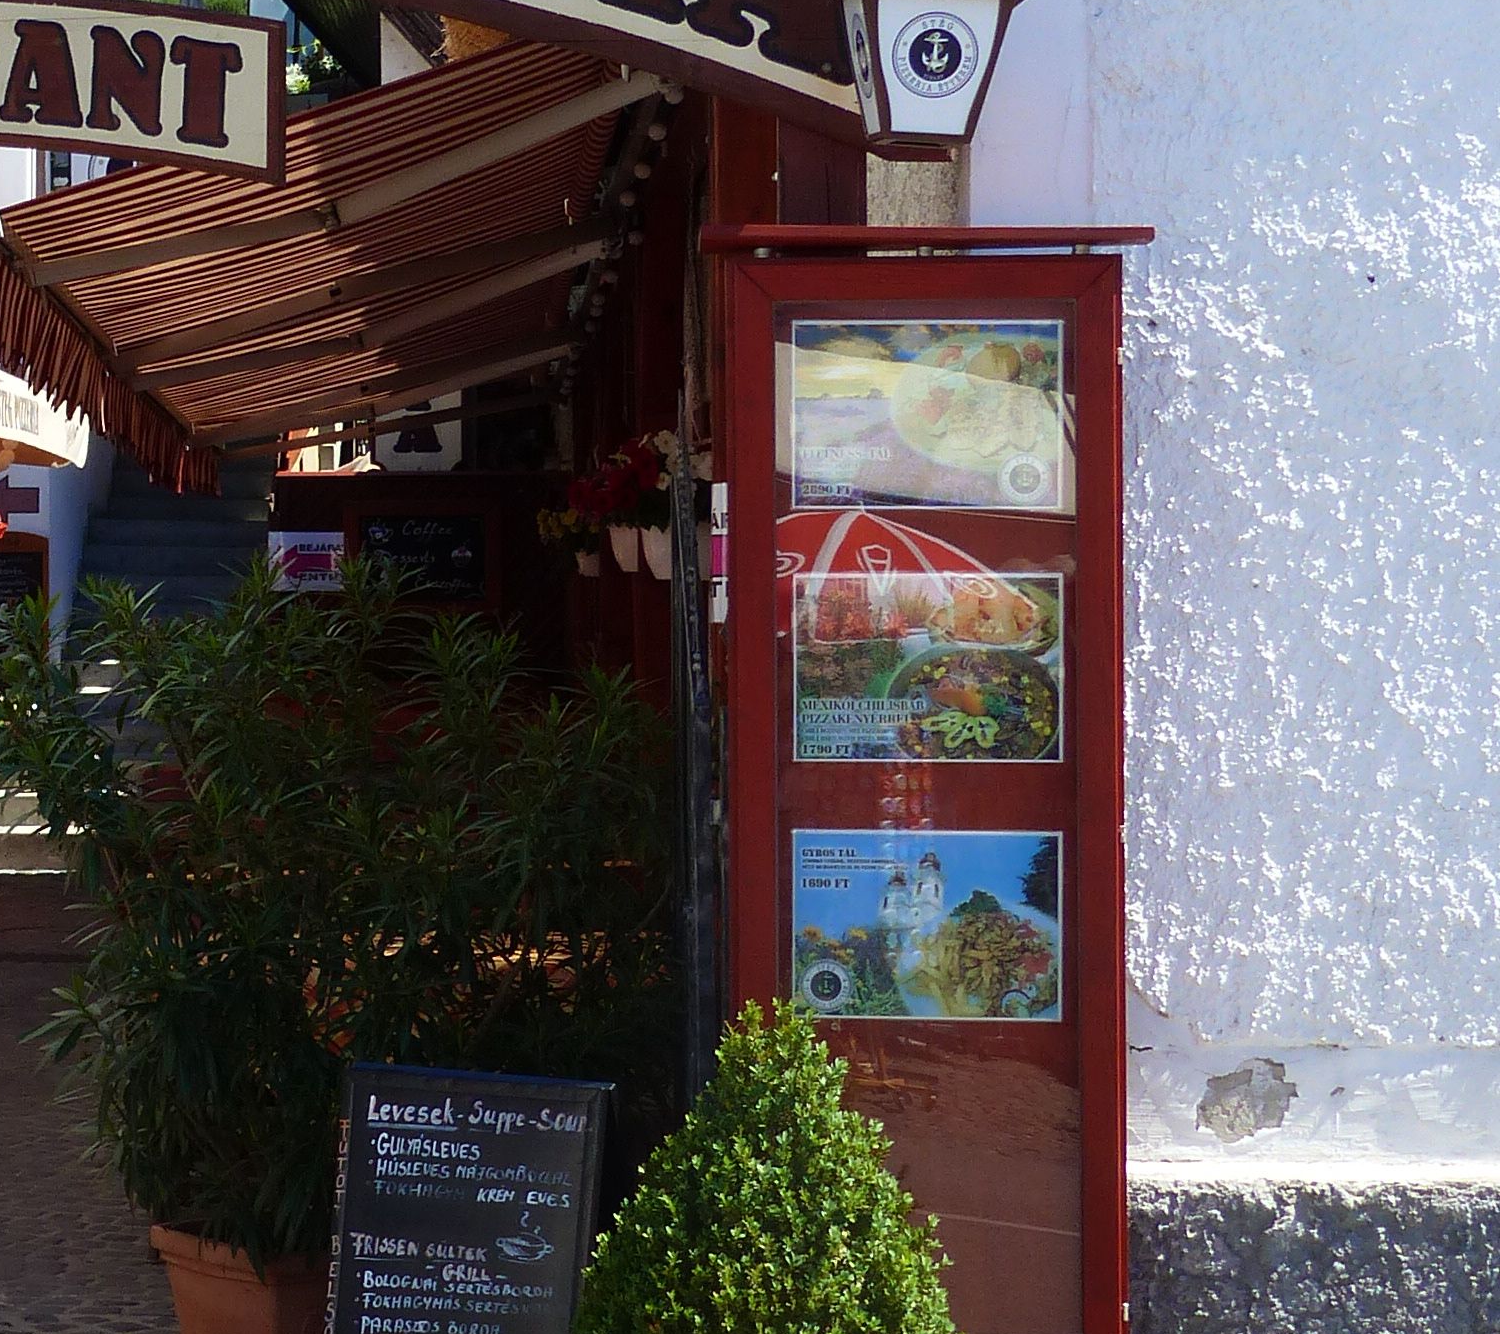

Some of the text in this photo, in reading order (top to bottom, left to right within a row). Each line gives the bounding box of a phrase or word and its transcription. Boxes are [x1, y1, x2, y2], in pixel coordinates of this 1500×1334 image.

[299, 541, 344, 552] BEJÁRA
[835, 745, 850, 755] FT
[802, 848, 835, 857] GYROS
[835, 878, 850, 888] FT
[376, 1132, 481, 1161] GULYÁSLEVES
[375, 1158, 451, 1180] HÚSLEVES
[442, 1263, 492, 1282] GRILL
